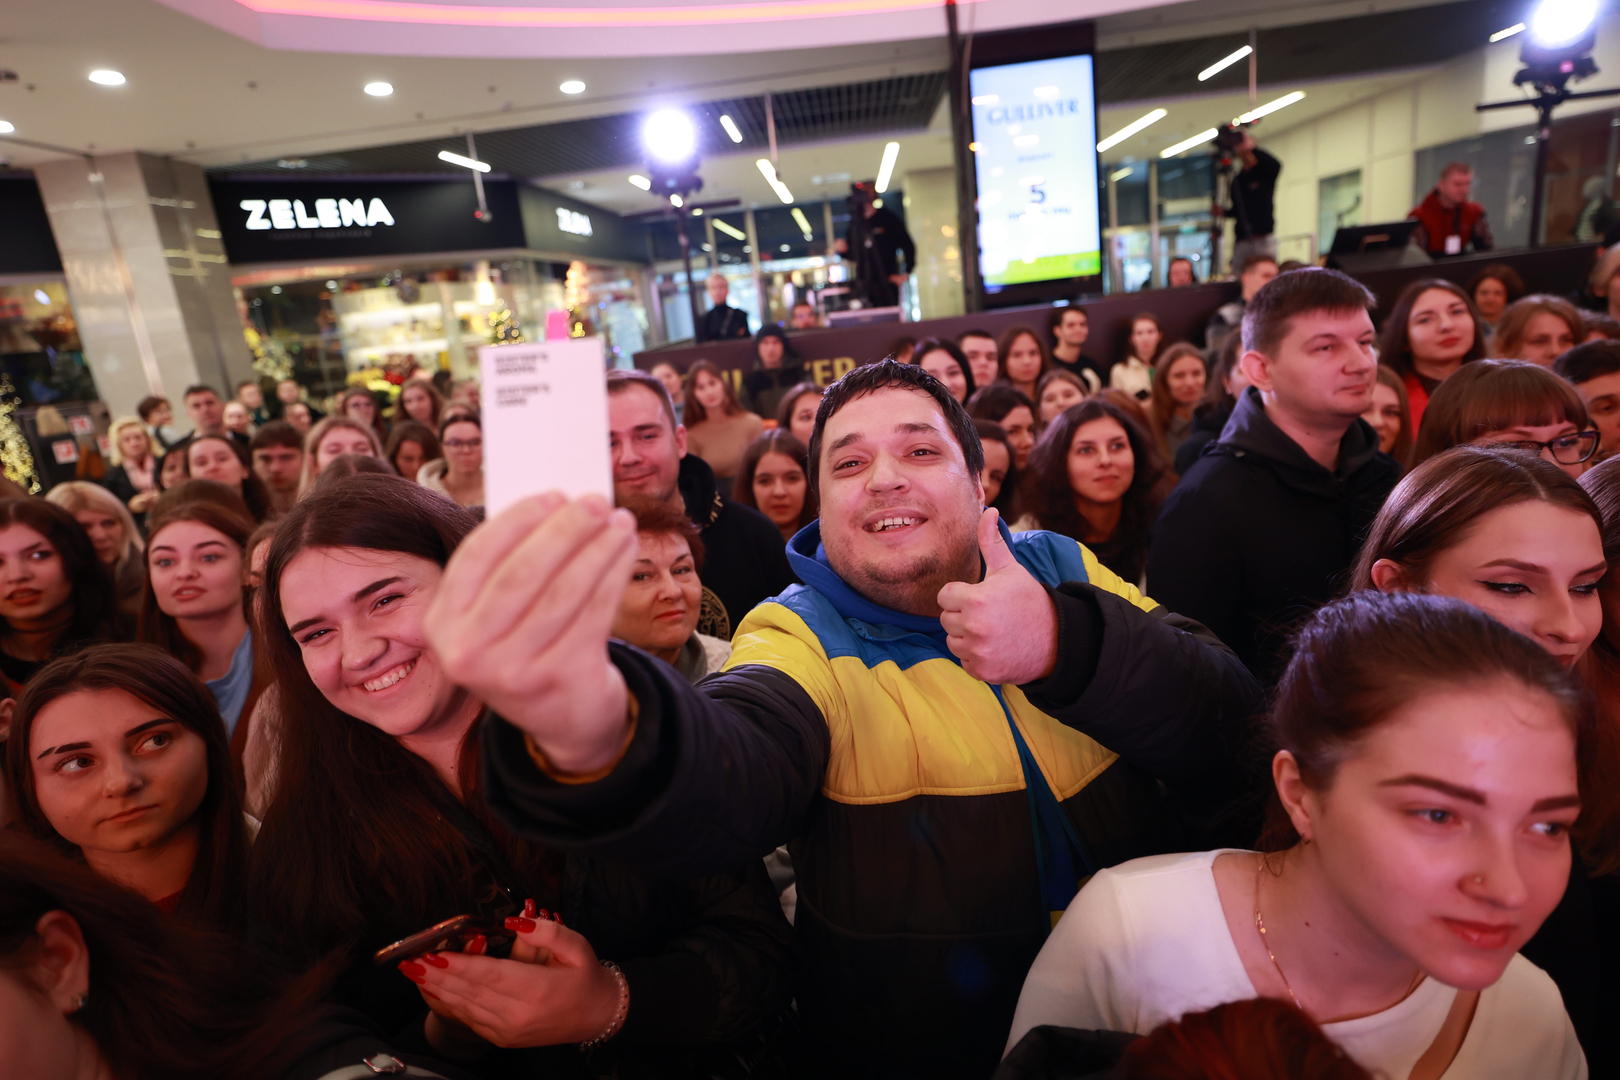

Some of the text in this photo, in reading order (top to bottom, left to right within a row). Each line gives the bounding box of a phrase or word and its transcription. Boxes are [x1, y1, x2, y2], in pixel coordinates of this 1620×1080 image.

[987, 101, 1079, 124] GULLIVER
[1030, 180, 1047, 204] 5
[240, 197, 395, 230] ZELENA
